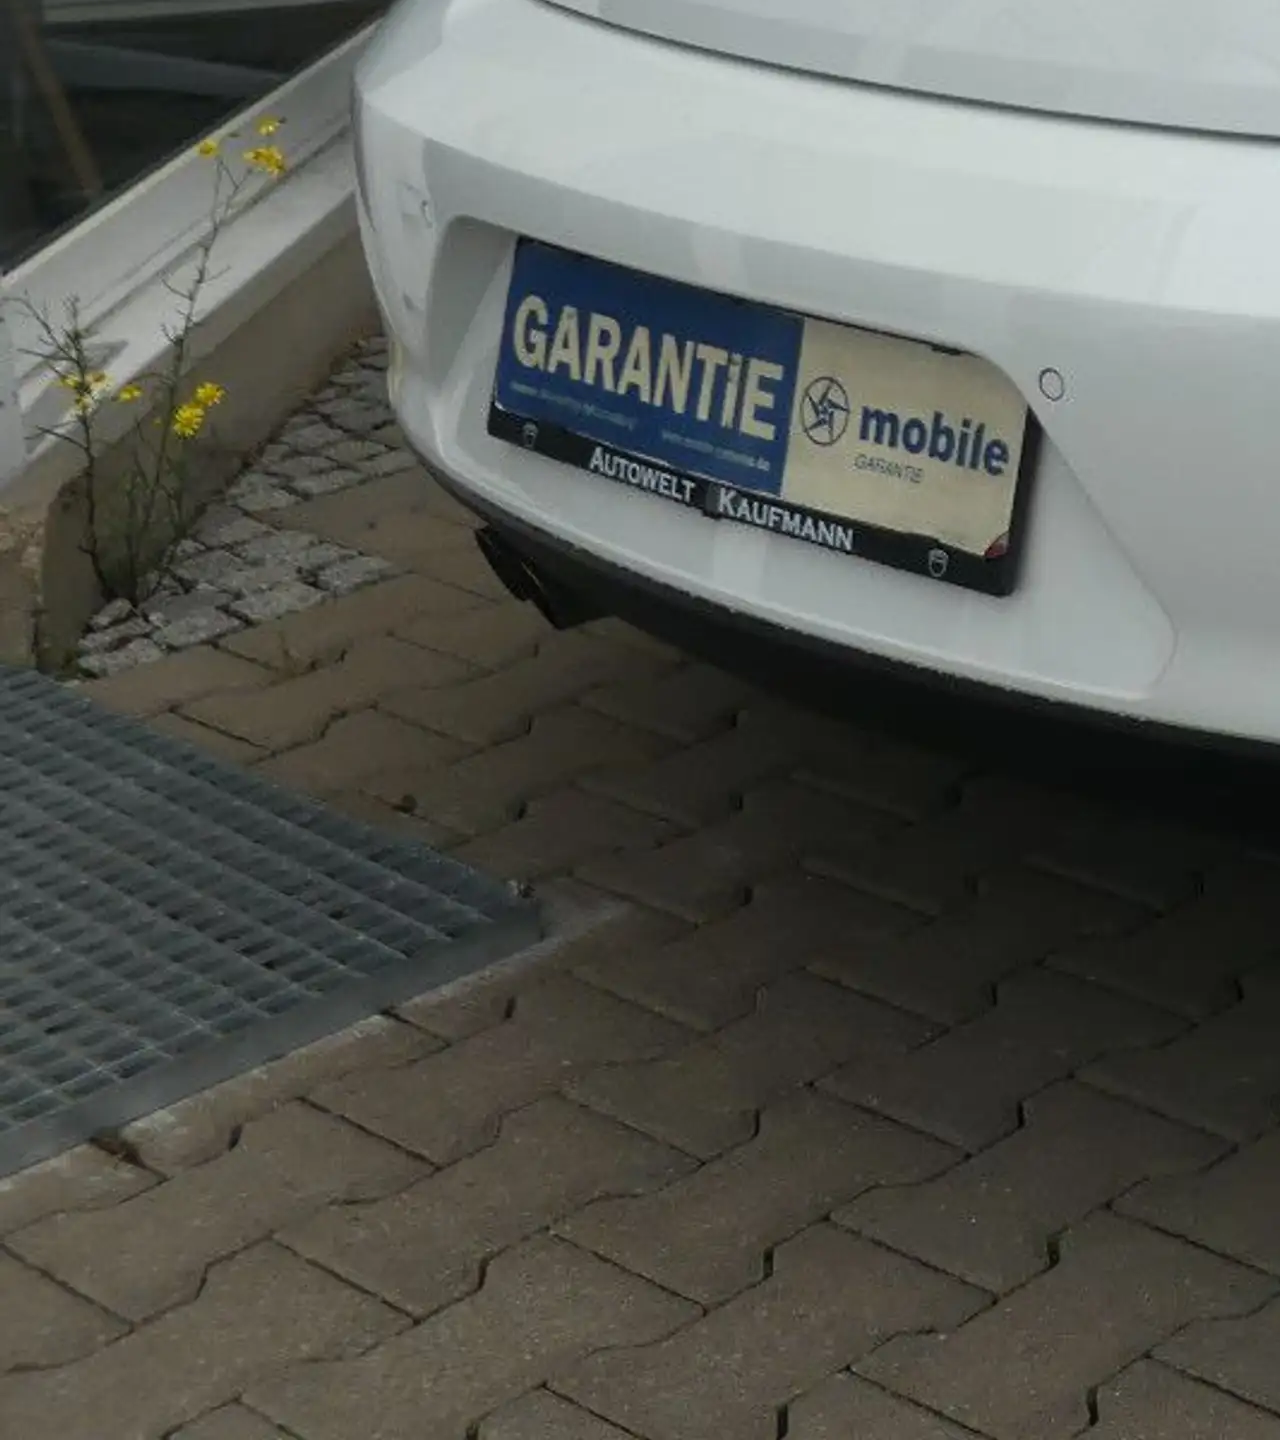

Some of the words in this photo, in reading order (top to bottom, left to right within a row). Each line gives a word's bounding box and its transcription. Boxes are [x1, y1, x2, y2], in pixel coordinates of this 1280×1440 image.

[858, 405, 1010, 476] mobile
[589, 446, 696, 502] AUTOWELT
[718, 487, 854, 551] KAUFMANN
